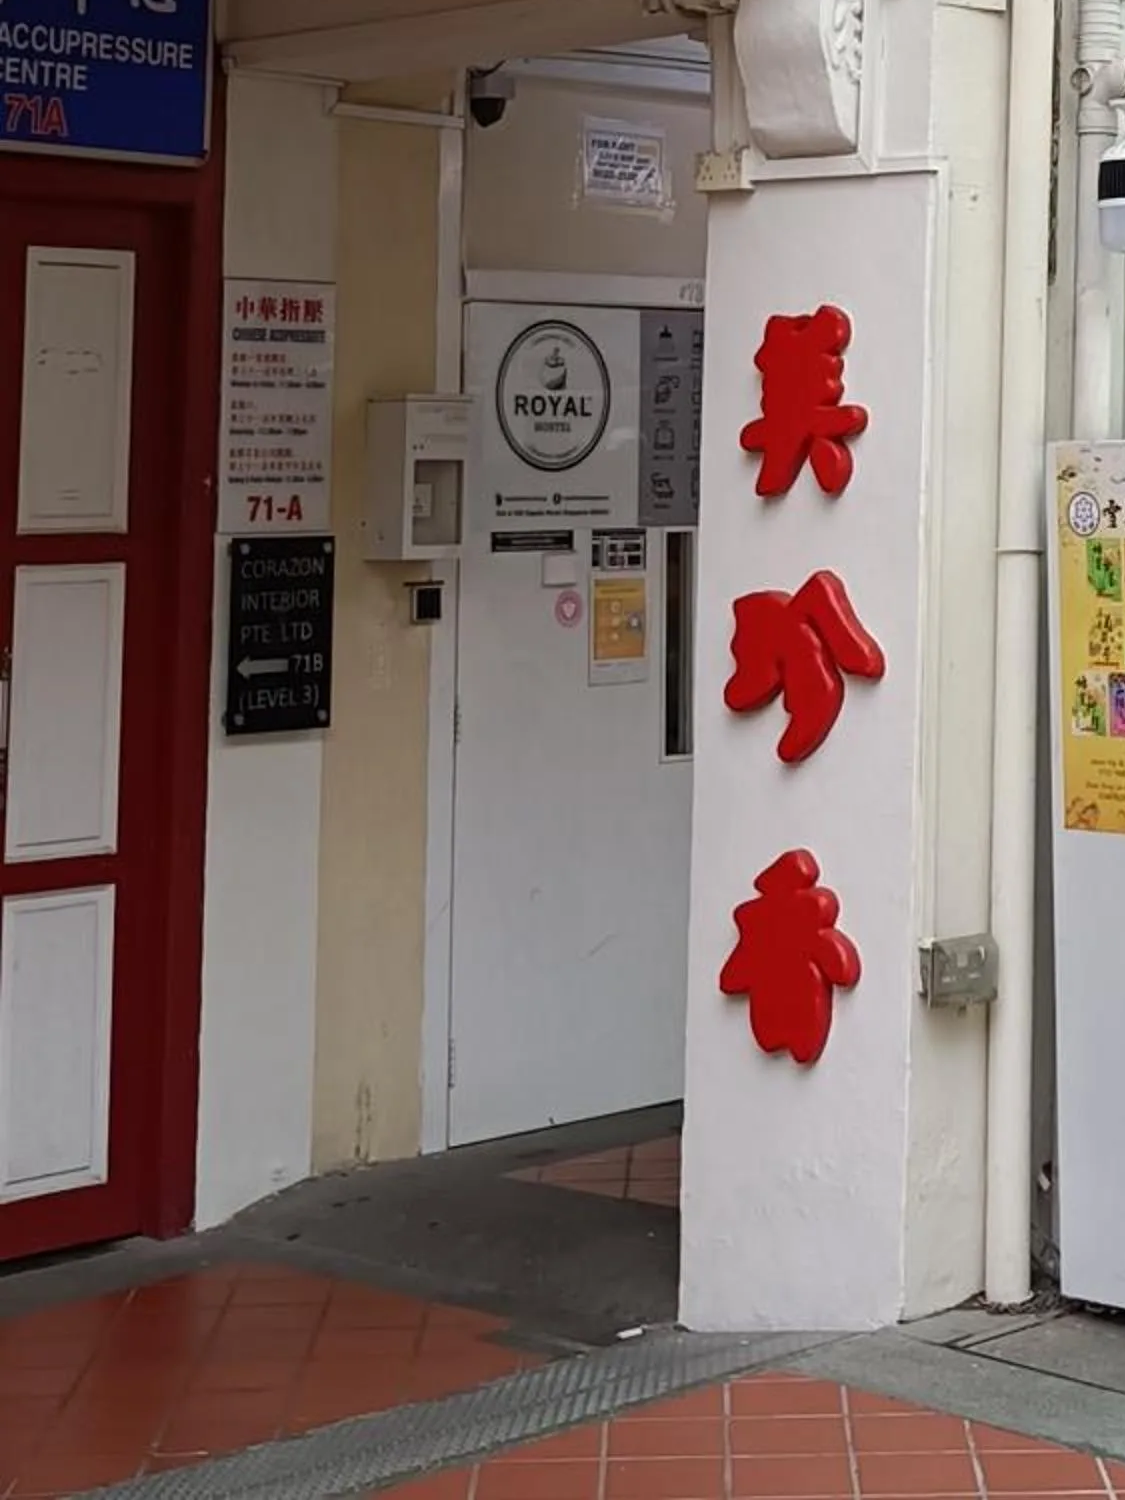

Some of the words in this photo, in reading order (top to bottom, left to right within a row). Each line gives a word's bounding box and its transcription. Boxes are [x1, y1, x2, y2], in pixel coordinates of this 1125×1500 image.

[0, 22, 194, 70] ACCUPRESSURE
[5, 94, 68, 138] 71A
[236, 294, 324, 323] 中華指壓
[513, 394, 592, 418] ROYAL
[247, 495, 303, 523] 71-A
[241, 558, 325, 580] CORAZON
[241, 588, 320, 612] INTERIOR
[240, 625, 271, 644] PTE
[281, 622, 314, 642] LTD
[290, 653, 324, 673] 71B
[239, 687, 297, 712] (LEVEL
[302, 684, 320, 708] 3)
